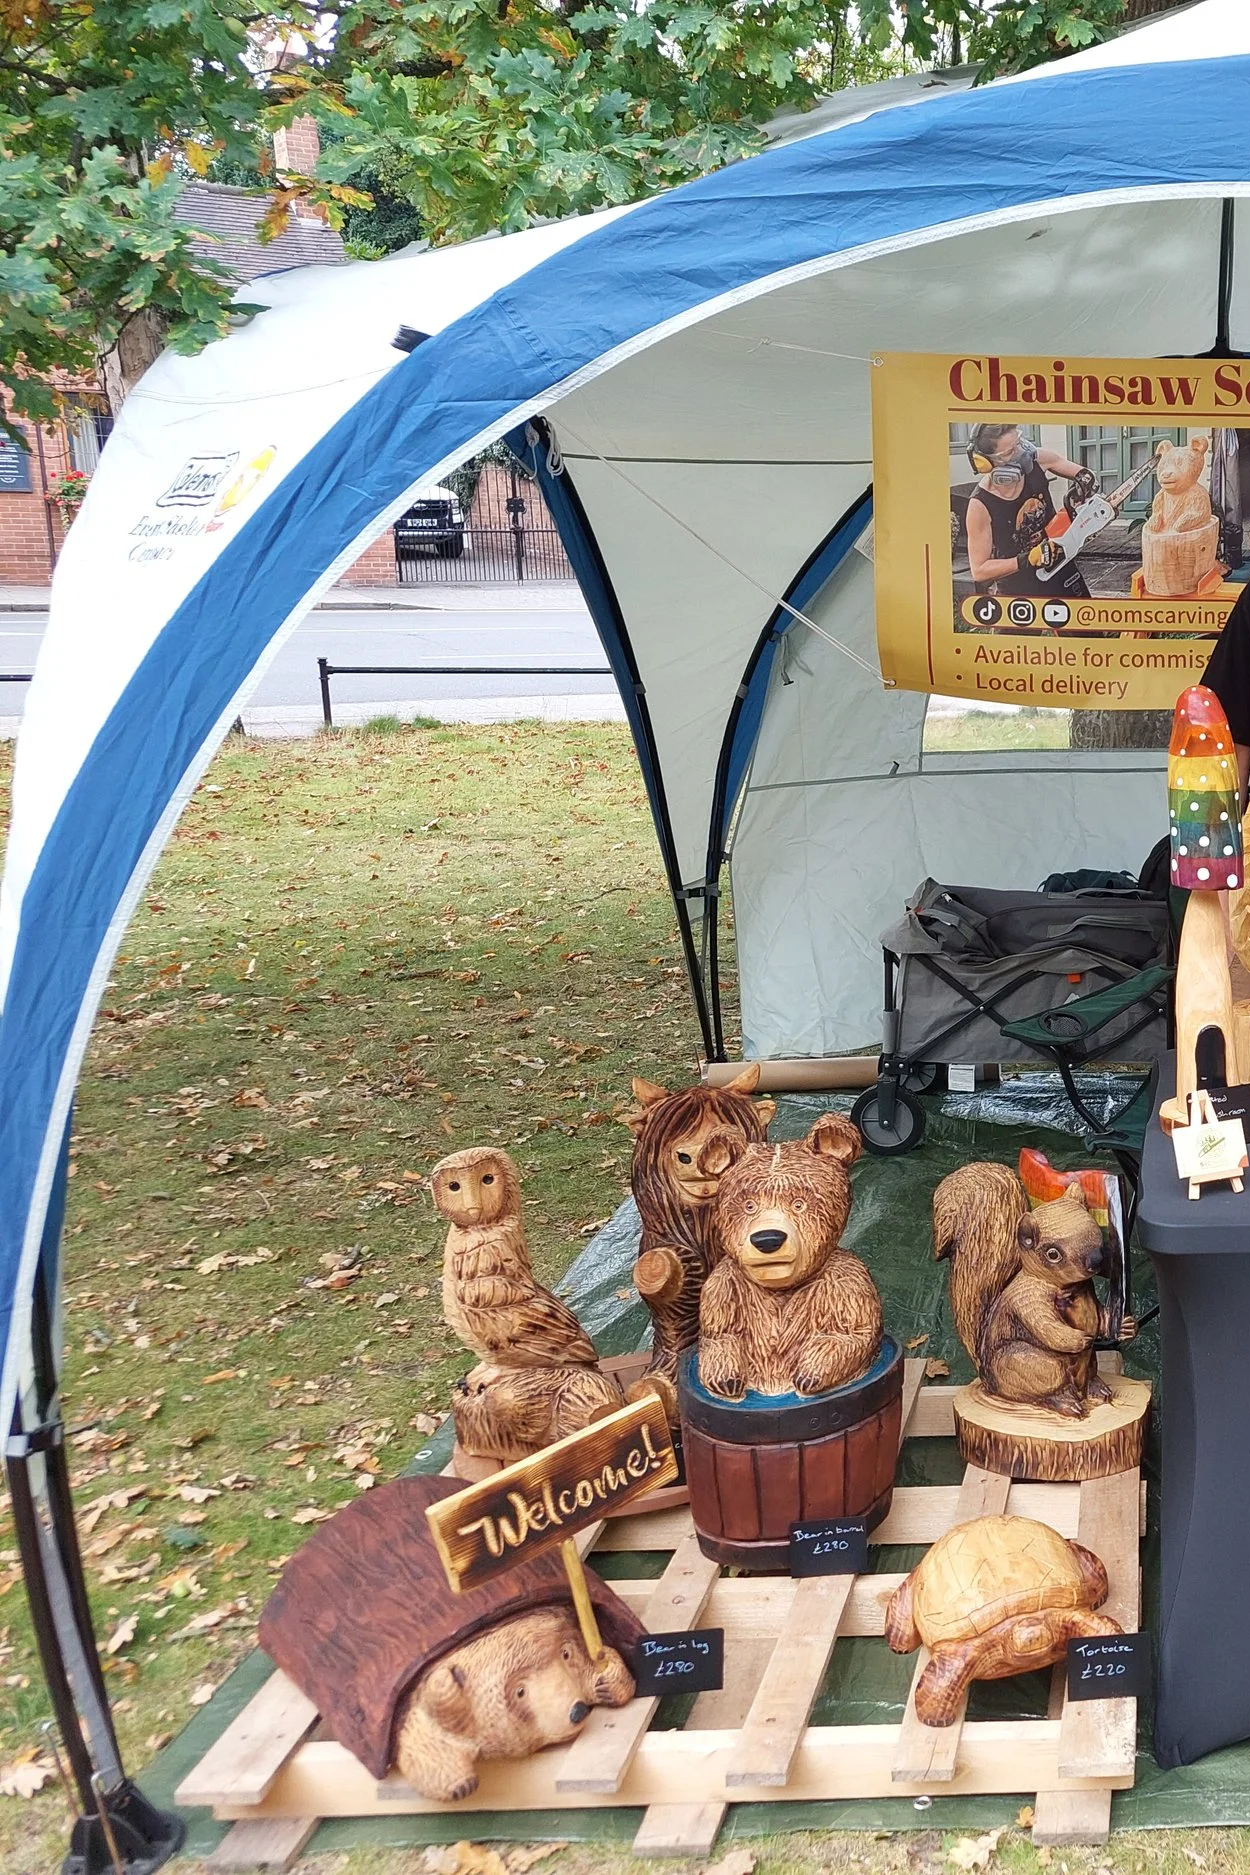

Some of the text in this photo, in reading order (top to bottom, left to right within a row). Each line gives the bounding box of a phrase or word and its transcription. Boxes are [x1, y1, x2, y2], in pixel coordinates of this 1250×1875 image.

[949, 357, 1200, 405] Chainsaw
[1076, 605, 1228, 630] @nomscarving
[974, 644, 1212, 669] Available for commis
[975, 672, 1129, 700] Local delivery
[456, 1423, 662, 1558] Welcome!
[793, 1529, 823, 1542] Bear
[824, 1527, 833, 1536] in
[812, 1540, 849, 1555] £280
[641, 1641, 676, 1657] Bear
[1075, 1640, 1134, 1657] Tortoise
[653, 1660, 695, 1678] £280
[1080, 1663, 1126, 1680] £220
